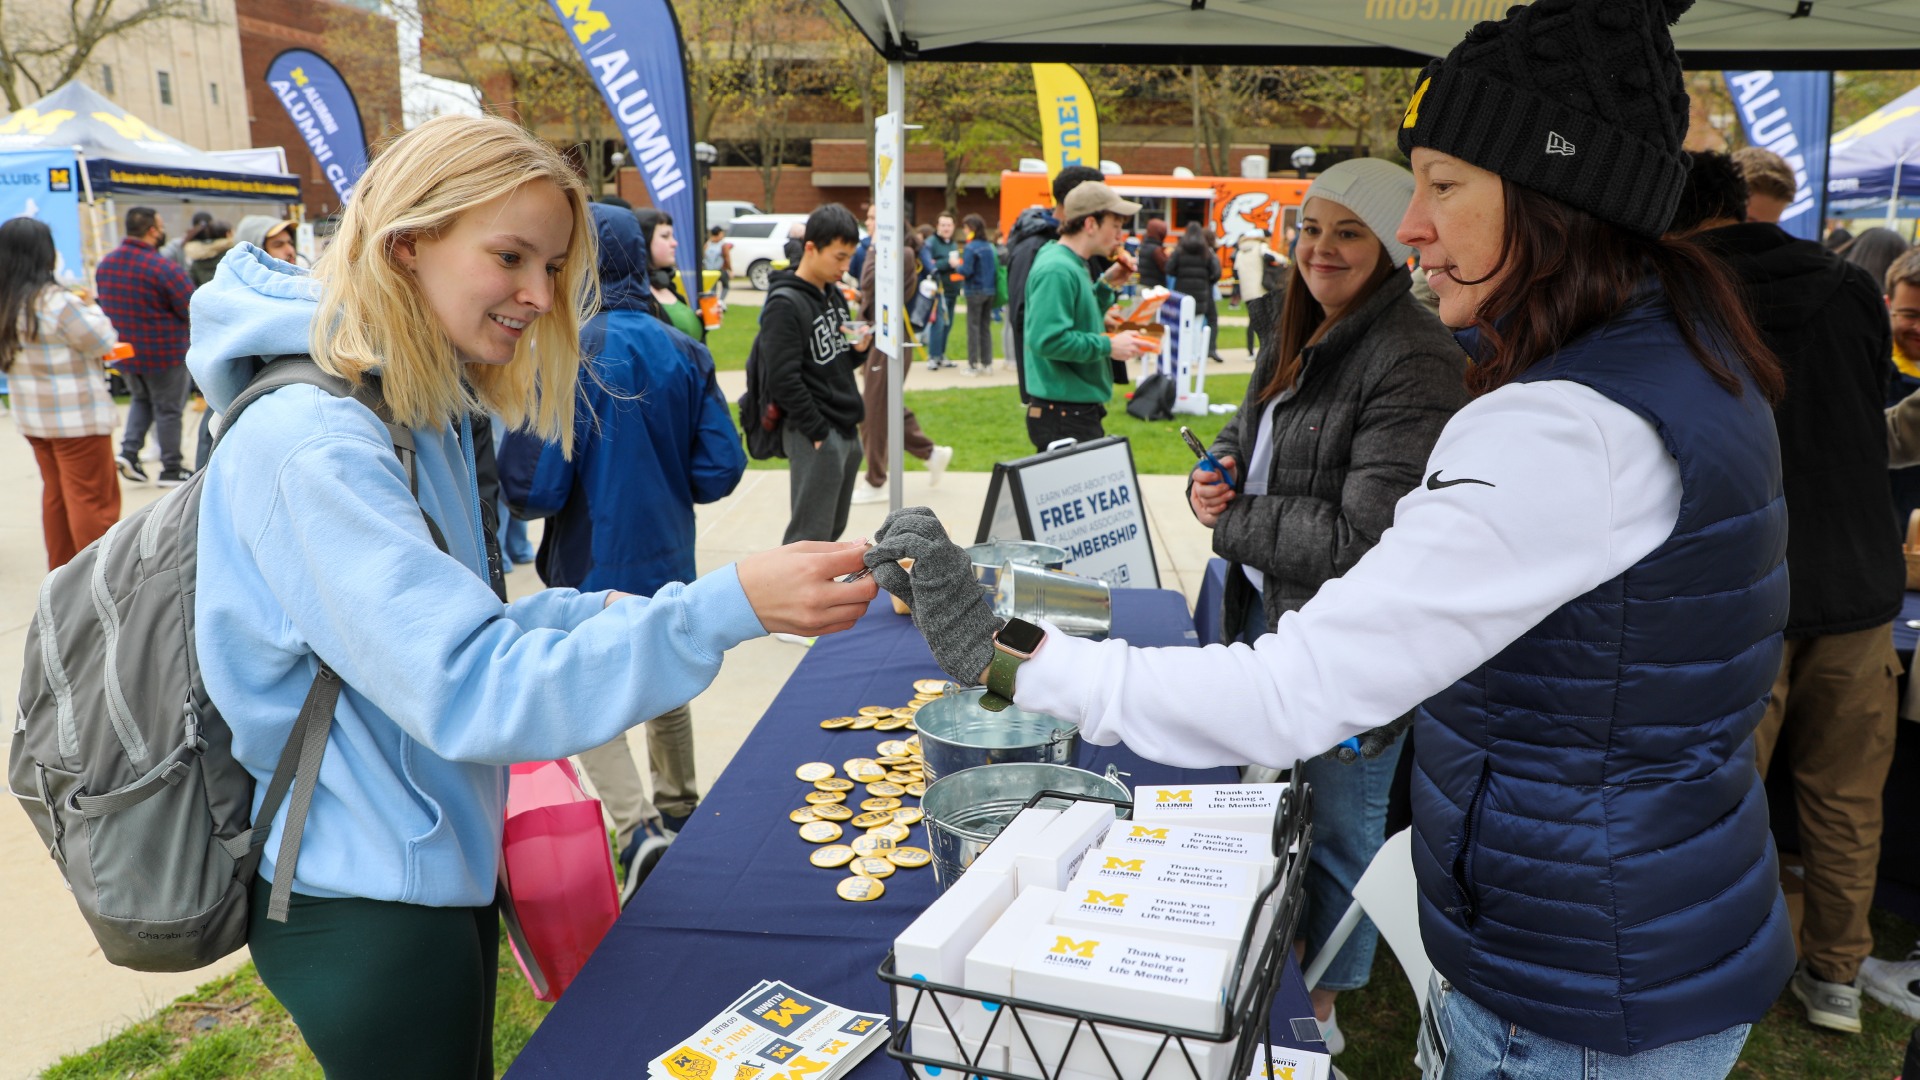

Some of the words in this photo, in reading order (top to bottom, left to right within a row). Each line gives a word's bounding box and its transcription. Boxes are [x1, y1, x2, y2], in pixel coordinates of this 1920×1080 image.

[556, 0, 612, 45] M
[270, 80, 334, 163] ALUMNI
[590, 49, 687, 202] ALUMNI
[0, 173, 41, 186] LUBS
[1036, 489, 1062, 506] LEARN
[1062, 483, 1083, 497] MORE
[1084, 477, 1107, 491] ABOUT
[1107, 470, 1126, 483] YOUR
[1040, 499, 1086, 532] FREE
[1086, 485, 1131, 515] YEAR
[1059, 524, 1088, 542] ALUMNI
[1089, 509, 1135, 531] ASSOCIATION
[1064, 523, 1139, 565] EMBERSHIP
[1156, 790, 1193, 803] M
[1129, 825, 1170, 839] M
[856, 838, 892, 850] BET
[1126, 837, 1166, 845] ALUMNI
[1206, 839, 1234, 848] being
[815, 849, 849, 859] BET
[890, 849, 928, 862] BET
[1202, 845, 1248, 854] Member!
[1102, 856, 1146, 872] M
[1169, 864, 1202, 872] Thank
[1099, 869, 1141, 878] ALUMNI
[1183, 871, 1213, 880] being
[1179, 878, 1228, 888] Member!
[1082, 889, 1129, 907] M
[1154, 899, 1188, 908] Thank
[1079, 904, 1124, 914] ALUMNI
[1168, 906, 1200, 917] being
[1140, 912, 1160, 920] Life
[1164, 915, 1216, 926] Member!
[1049, 935, 1100, 958] M
[1045, 954, 1092, 967] ALUMNI
[1127, 947, 1161, 959] Thank
[1164, 952, 1187, 963] you
[1121, 957, 1136, 966] for
[1140, 959, 1173, 973] being
[1109, 966, 1130, 975] Life
[1134, 969, 1189, 985] Member!
[752, 992, 786, 1016] ALUMNI
[762, 997, 812, 1029] M
[711, 1020, 730, 1036] BLUE!
[727, 1016, 738, 1026] GO
[851, 1019, 874, 1033] M
[723, 1024, 756, 1047] HAIL!
[771, 1045, 795, 1060] M
[821, 1039, 849, 1056] M
[674, 1055, 693, 1068] M
